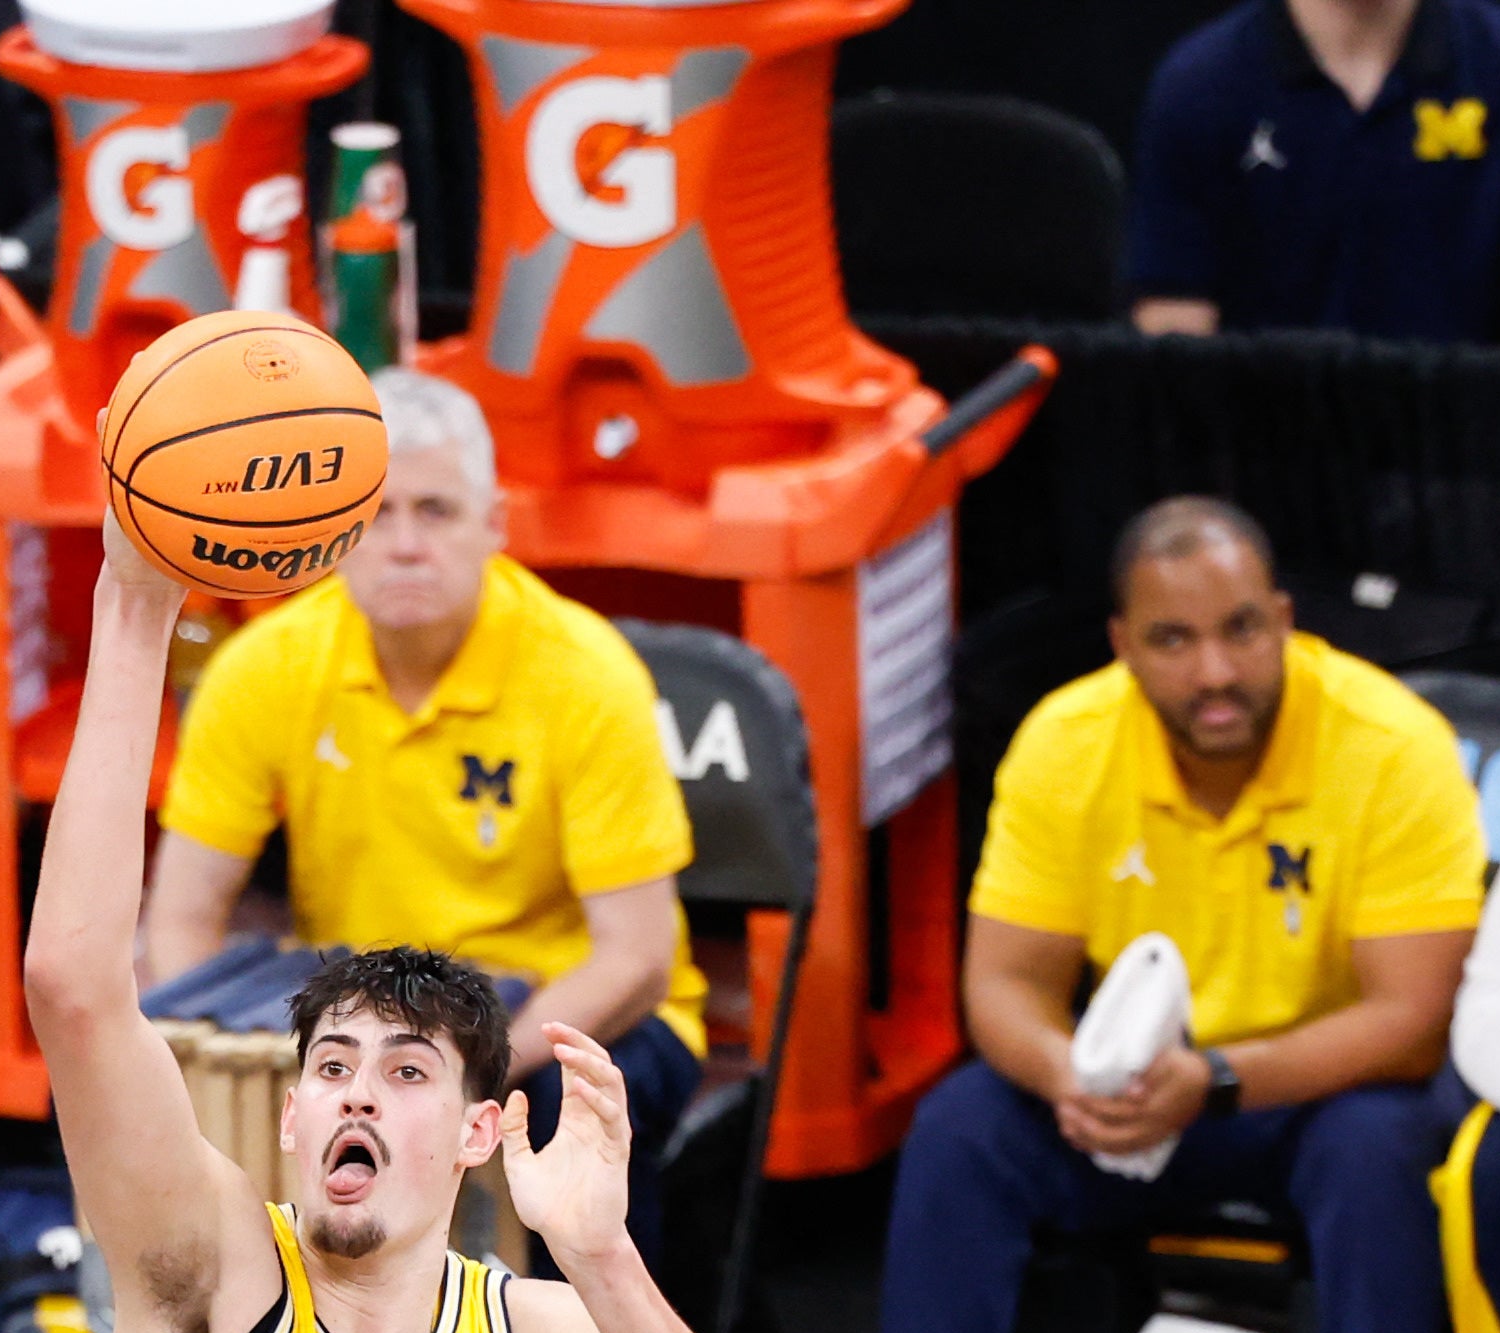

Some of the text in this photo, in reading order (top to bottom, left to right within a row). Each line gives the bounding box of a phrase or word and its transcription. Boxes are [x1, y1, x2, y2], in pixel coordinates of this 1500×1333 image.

[1414, 98, 1486, 161] M
[86, 125, 196, 250] G
[524, 75, 677, 247] G
[201, 480, 238, 495] NXT
[459, 753, 515, 808] M
[1267, 843, 1313, 895] M
